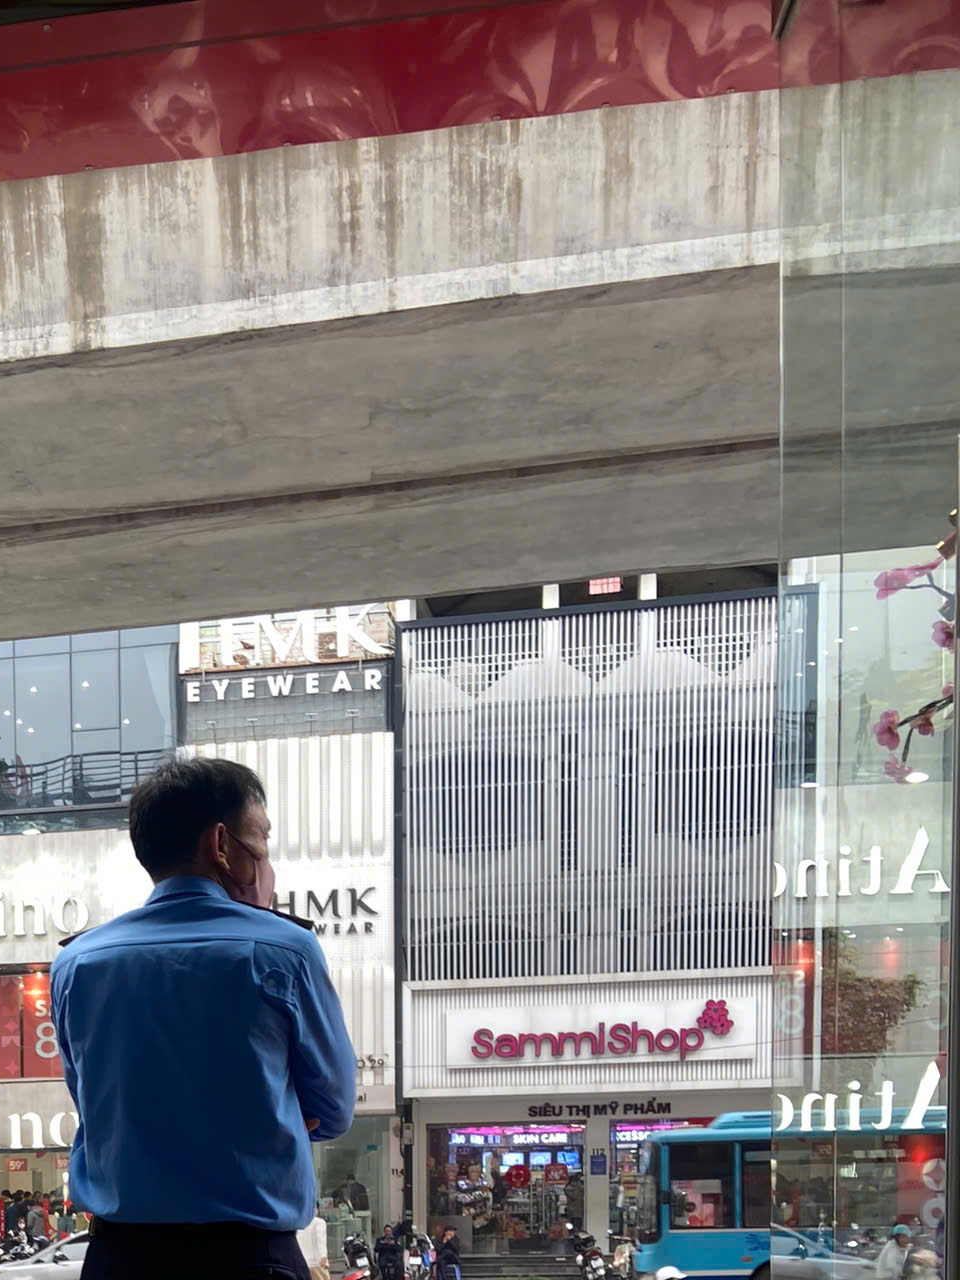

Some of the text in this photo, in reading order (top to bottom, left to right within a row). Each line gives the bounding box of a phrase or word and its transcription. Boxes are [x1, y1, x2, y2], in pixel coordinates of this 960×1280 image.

[186, 668, 383, 702] EYEWEAR
[272, 886, 379, 918] HMK
[314, 921, 374, 936] WEAR
[471, 1020, 705, 1062] SammiShop
[528, 1097, 671, 1119] SIÊU THỊ MỸ PHẨM
